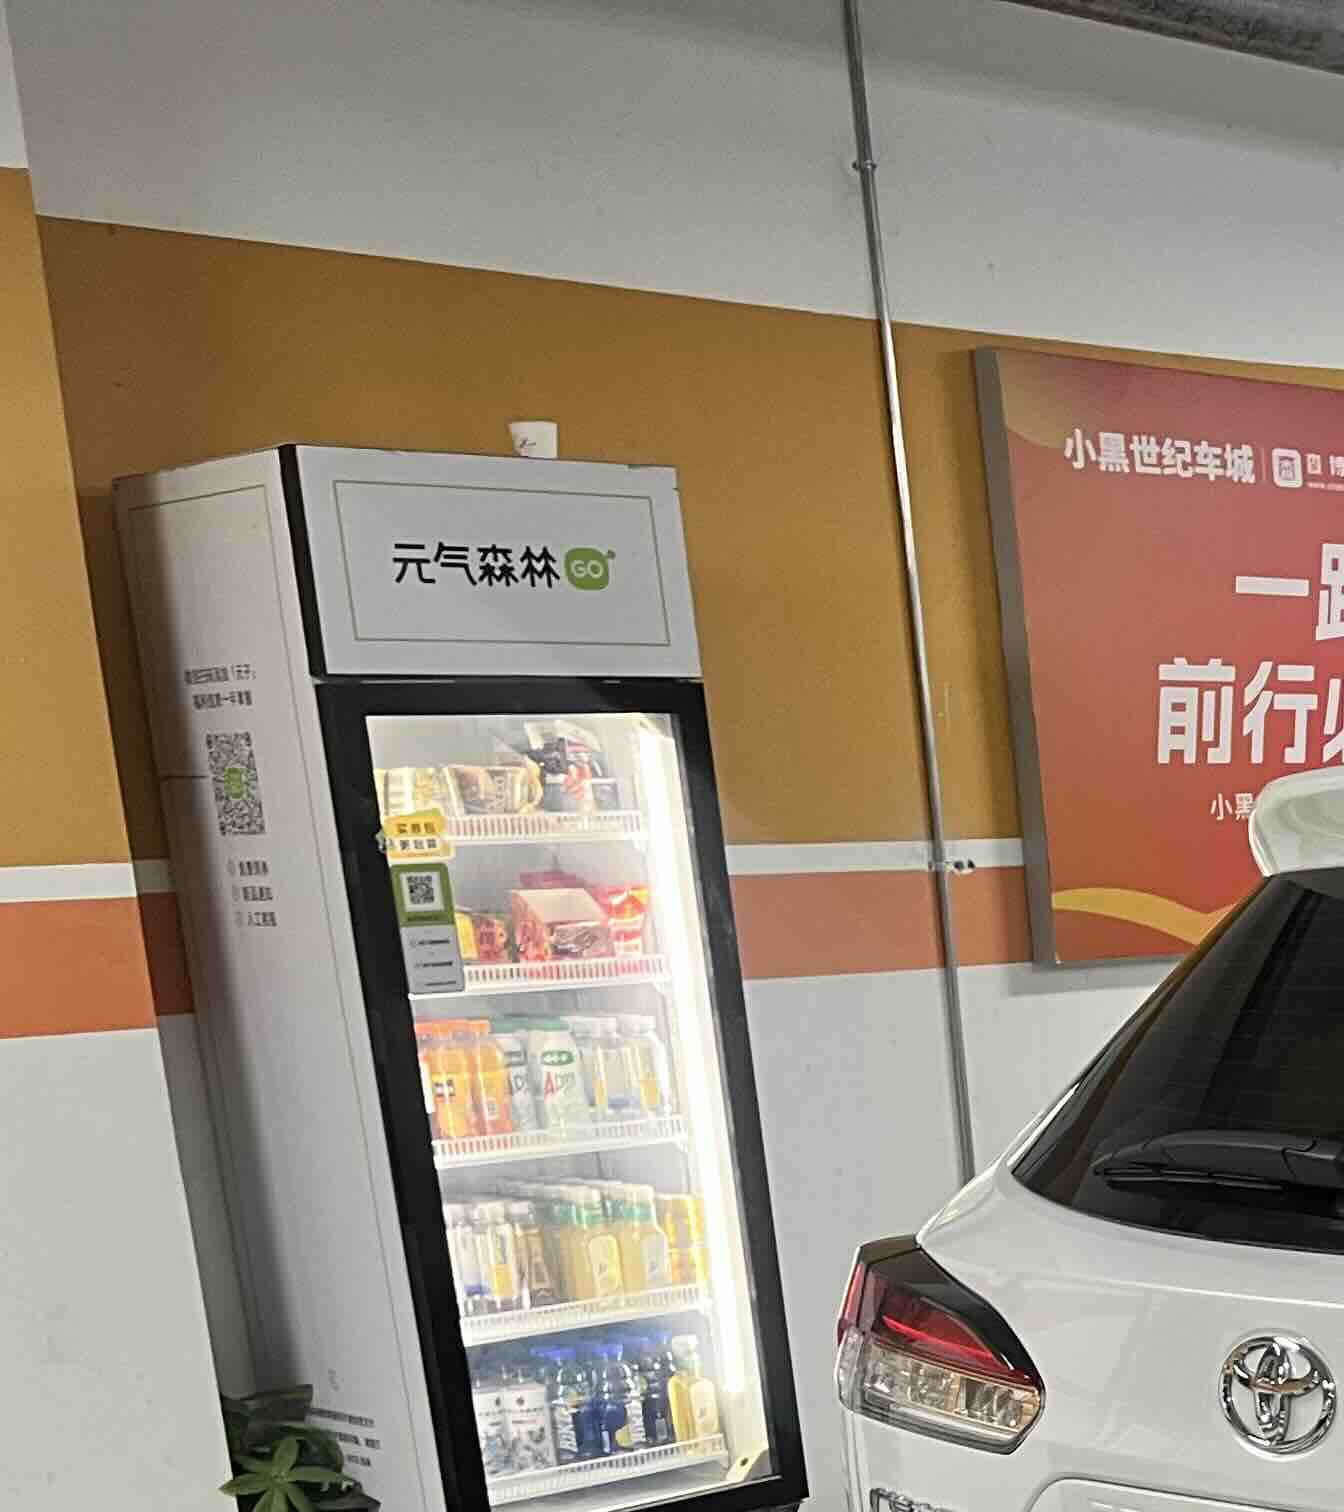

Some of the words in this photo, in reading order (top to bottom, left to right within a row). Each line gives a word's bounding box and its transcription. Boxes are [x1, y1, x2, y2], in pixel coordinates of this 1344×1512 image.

[1063, 428, 1256, 483] 小黑世纪车城
[393, 542, 560, 588] 元气森林
[571, 559, 604, 578] GO
